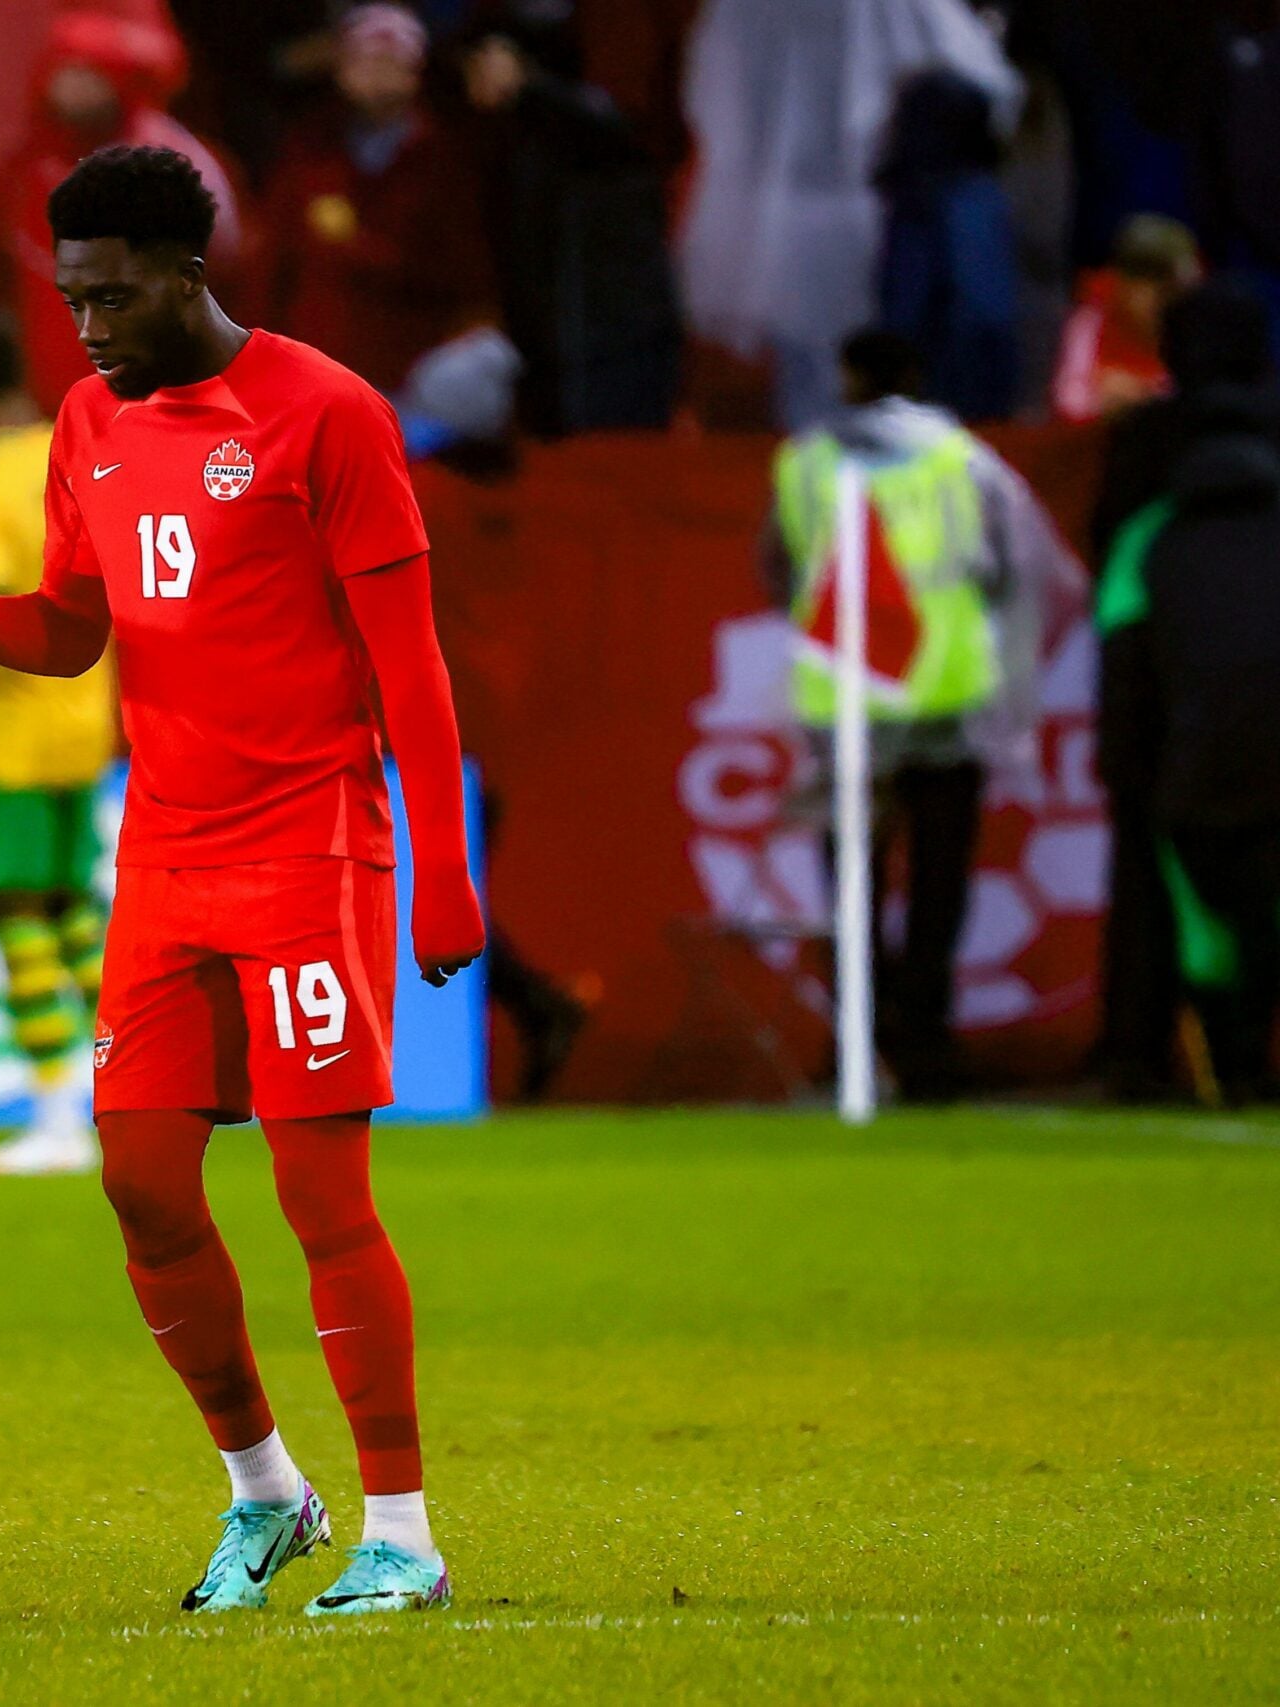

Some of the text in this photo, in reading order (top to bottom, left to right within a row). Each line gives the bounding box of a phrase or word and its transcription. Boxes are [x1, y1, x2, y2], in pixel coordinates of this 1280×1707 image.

[205, 466, 251, 477] CANADA
[136, 514, 197, 598] 19
[269, 961, 347, 1049] 19
